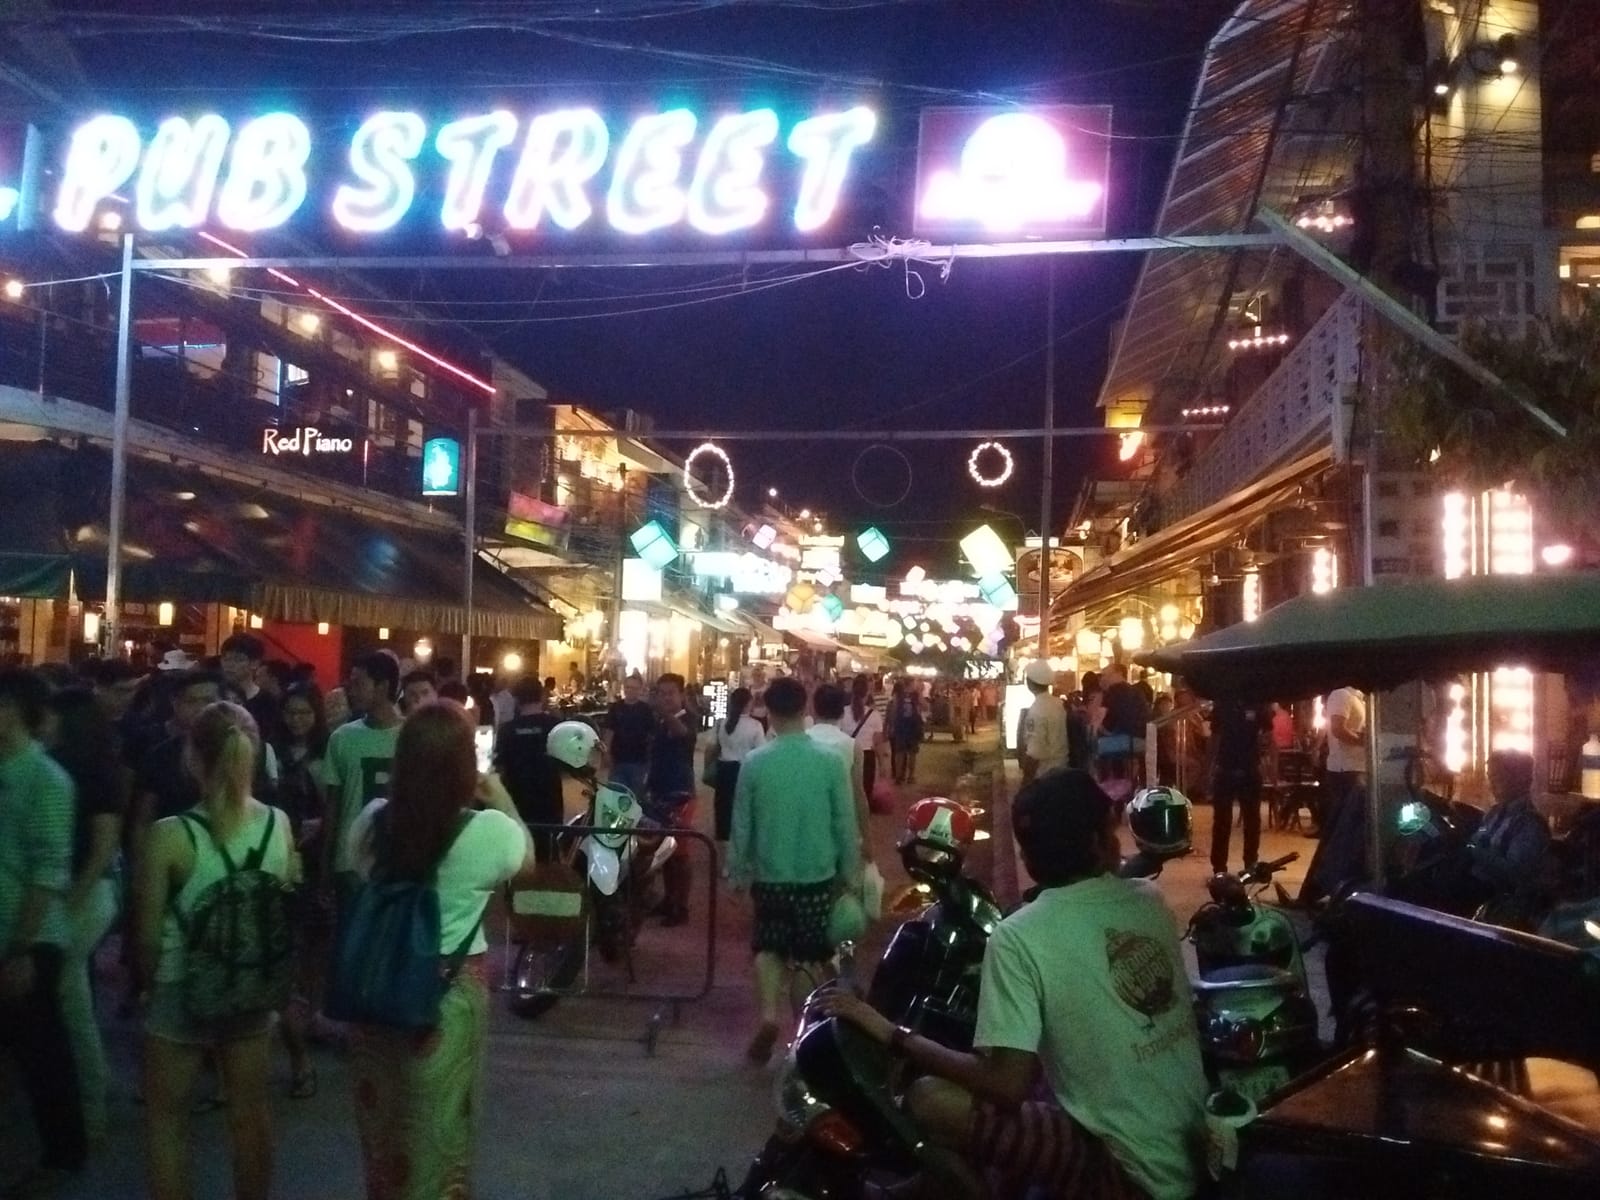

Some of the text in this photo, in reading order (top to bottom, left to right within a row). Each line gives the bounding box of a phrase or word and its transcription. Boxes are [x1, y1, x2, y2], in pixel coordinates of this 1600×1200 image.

[53, 106, 877, 234] PUB STREET
[263, 427, 353, 456] Red Piano
